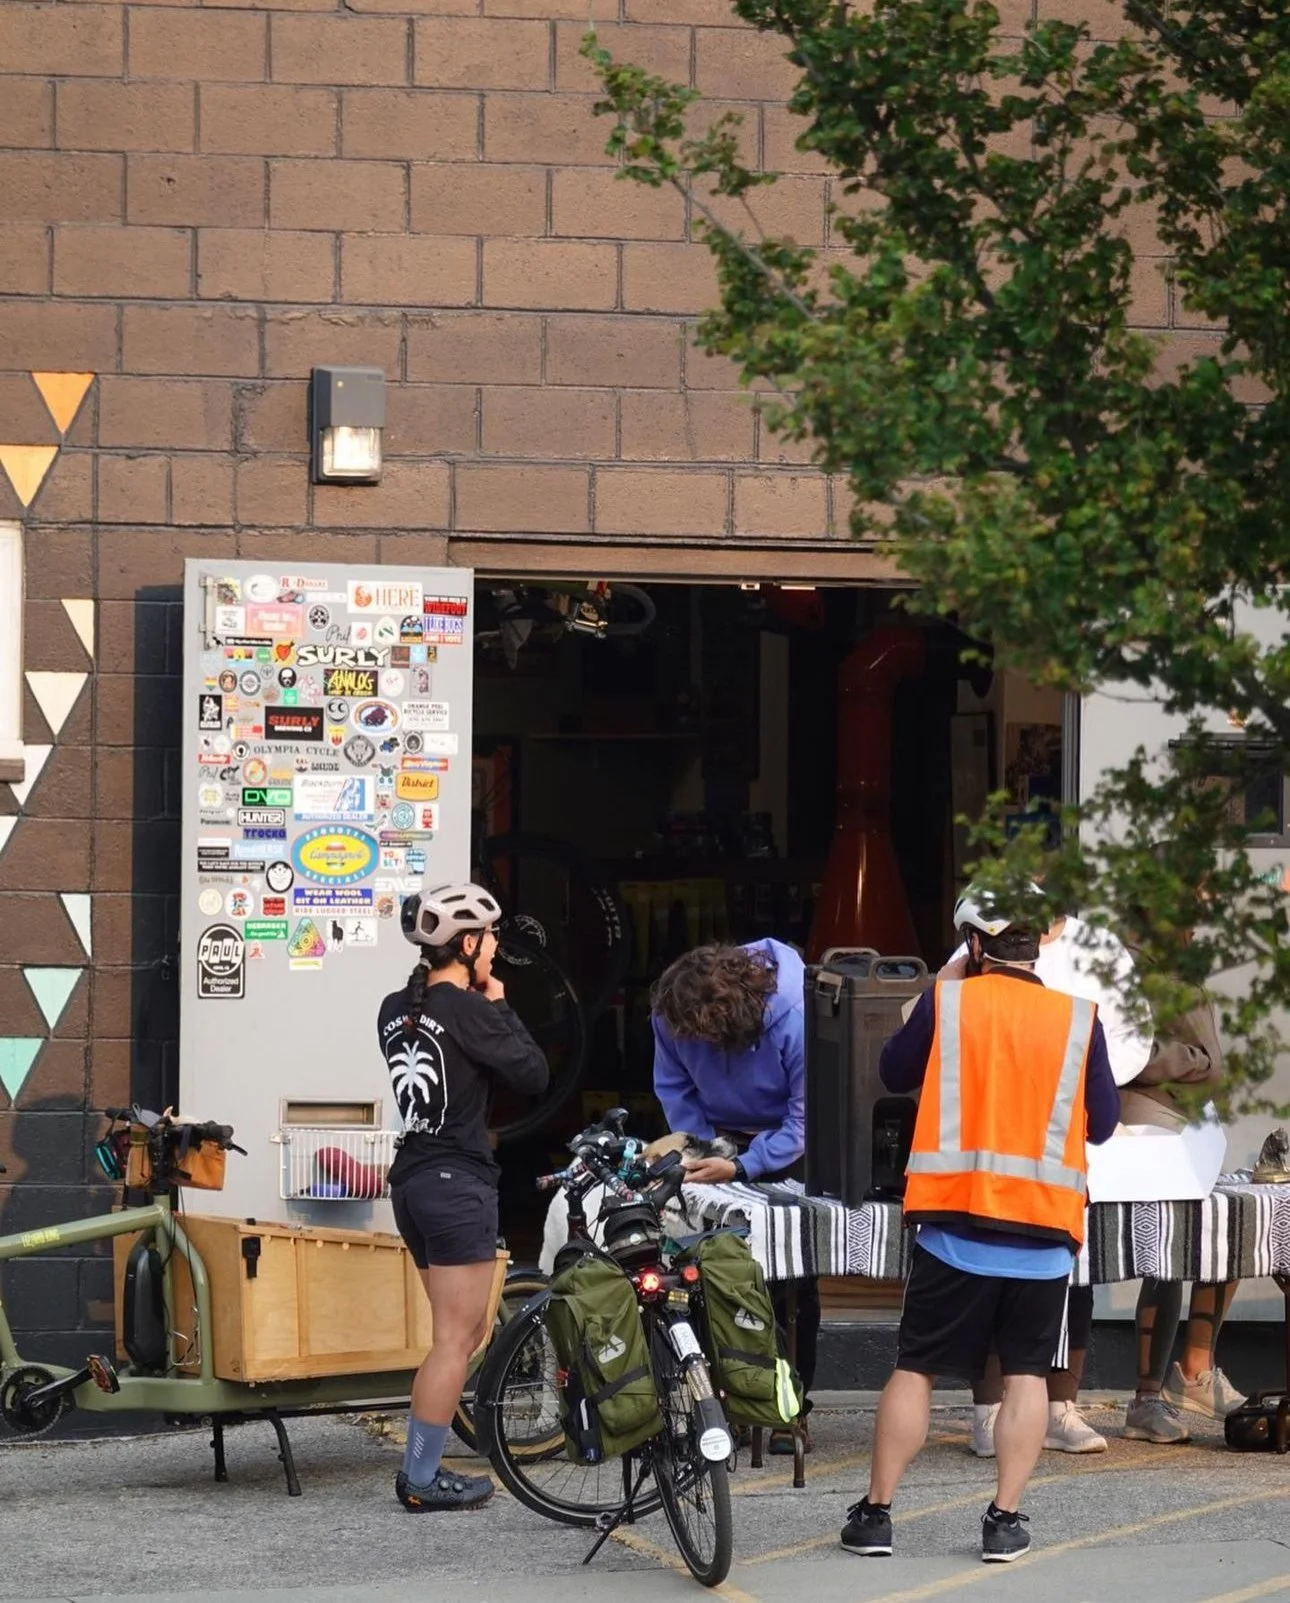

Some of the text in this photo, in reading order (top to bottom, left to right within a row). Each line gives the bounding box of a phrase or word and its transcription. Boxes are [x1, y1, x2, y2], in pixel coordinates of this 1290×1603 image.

[297, 644, 389, 668] SURLY
[327, 670, 375, 690] ANALOG
[268, 715, 320, 728] SURLY
[254, 746, 340, 757] OLYMPIA CYCLE
[401, 776, 434, 788] District
[245, 790, 290, 804] DVO
[241, 812, 281, 823] HUNTER
[334, 889, 362, 897] WOOL
[330, 897, 371, 905] LEATHER
[200, 943, 242, 959] PAUL
[203, 977, 239, 985] Authorized
[210, 984, 232, 993] Dealer
[419, 1014, 445, 1035] DIRT
